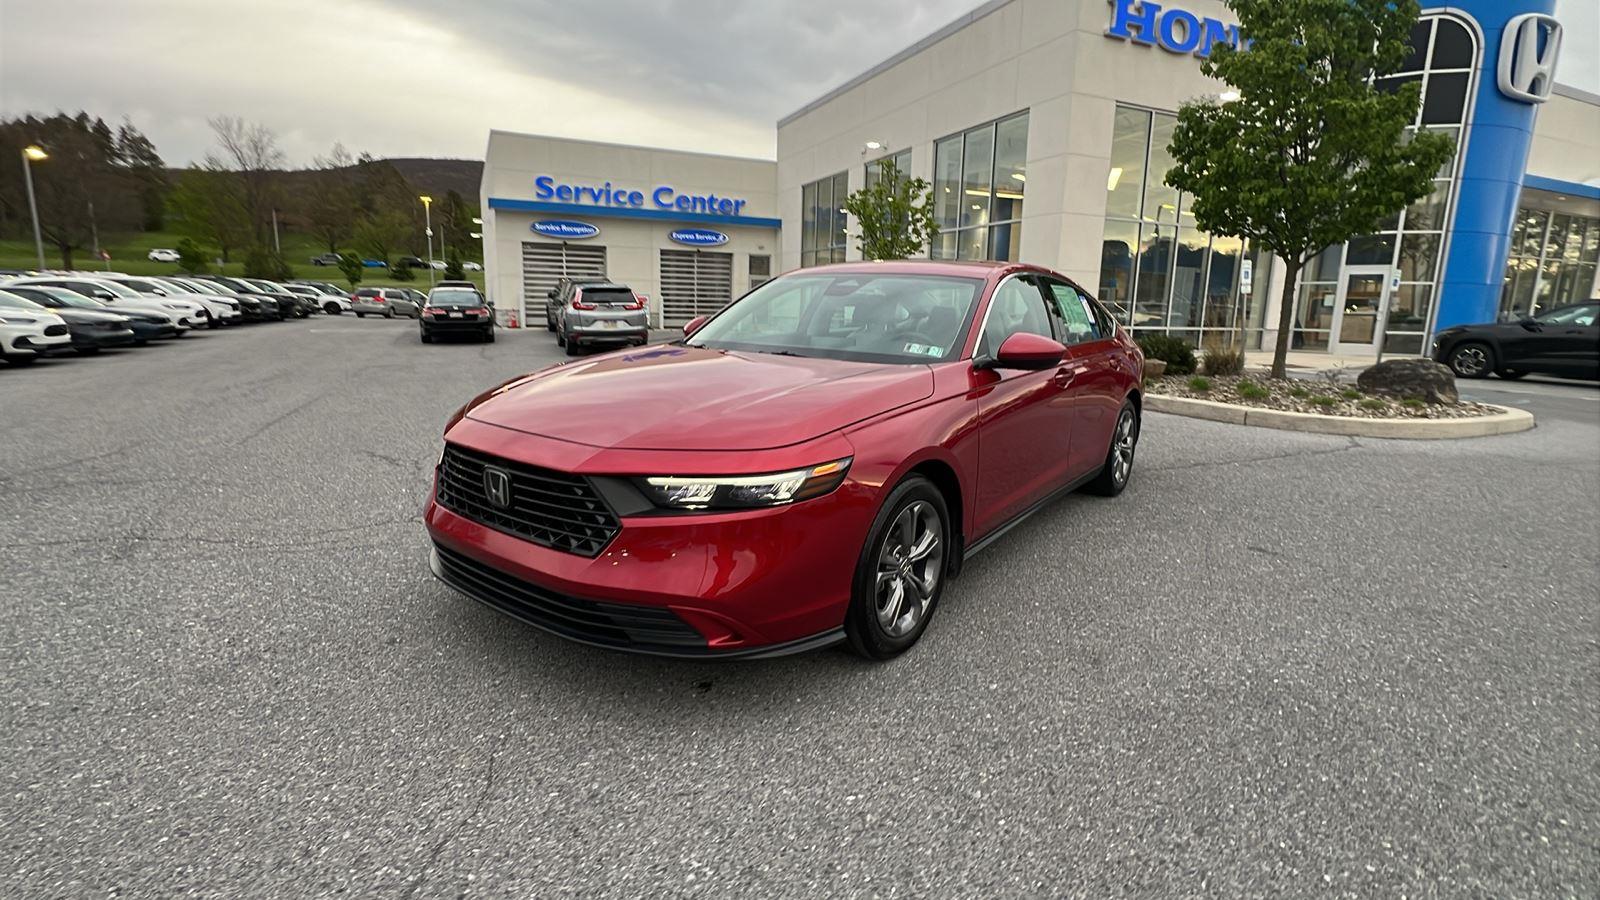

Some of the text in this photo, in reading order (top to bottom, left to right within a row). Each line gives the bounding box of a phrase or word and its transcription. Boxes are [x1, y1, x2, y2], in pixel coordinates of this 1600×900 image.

[1104, 0, 1252, 58] HON
[535, 176, 746, 215] Service Center
